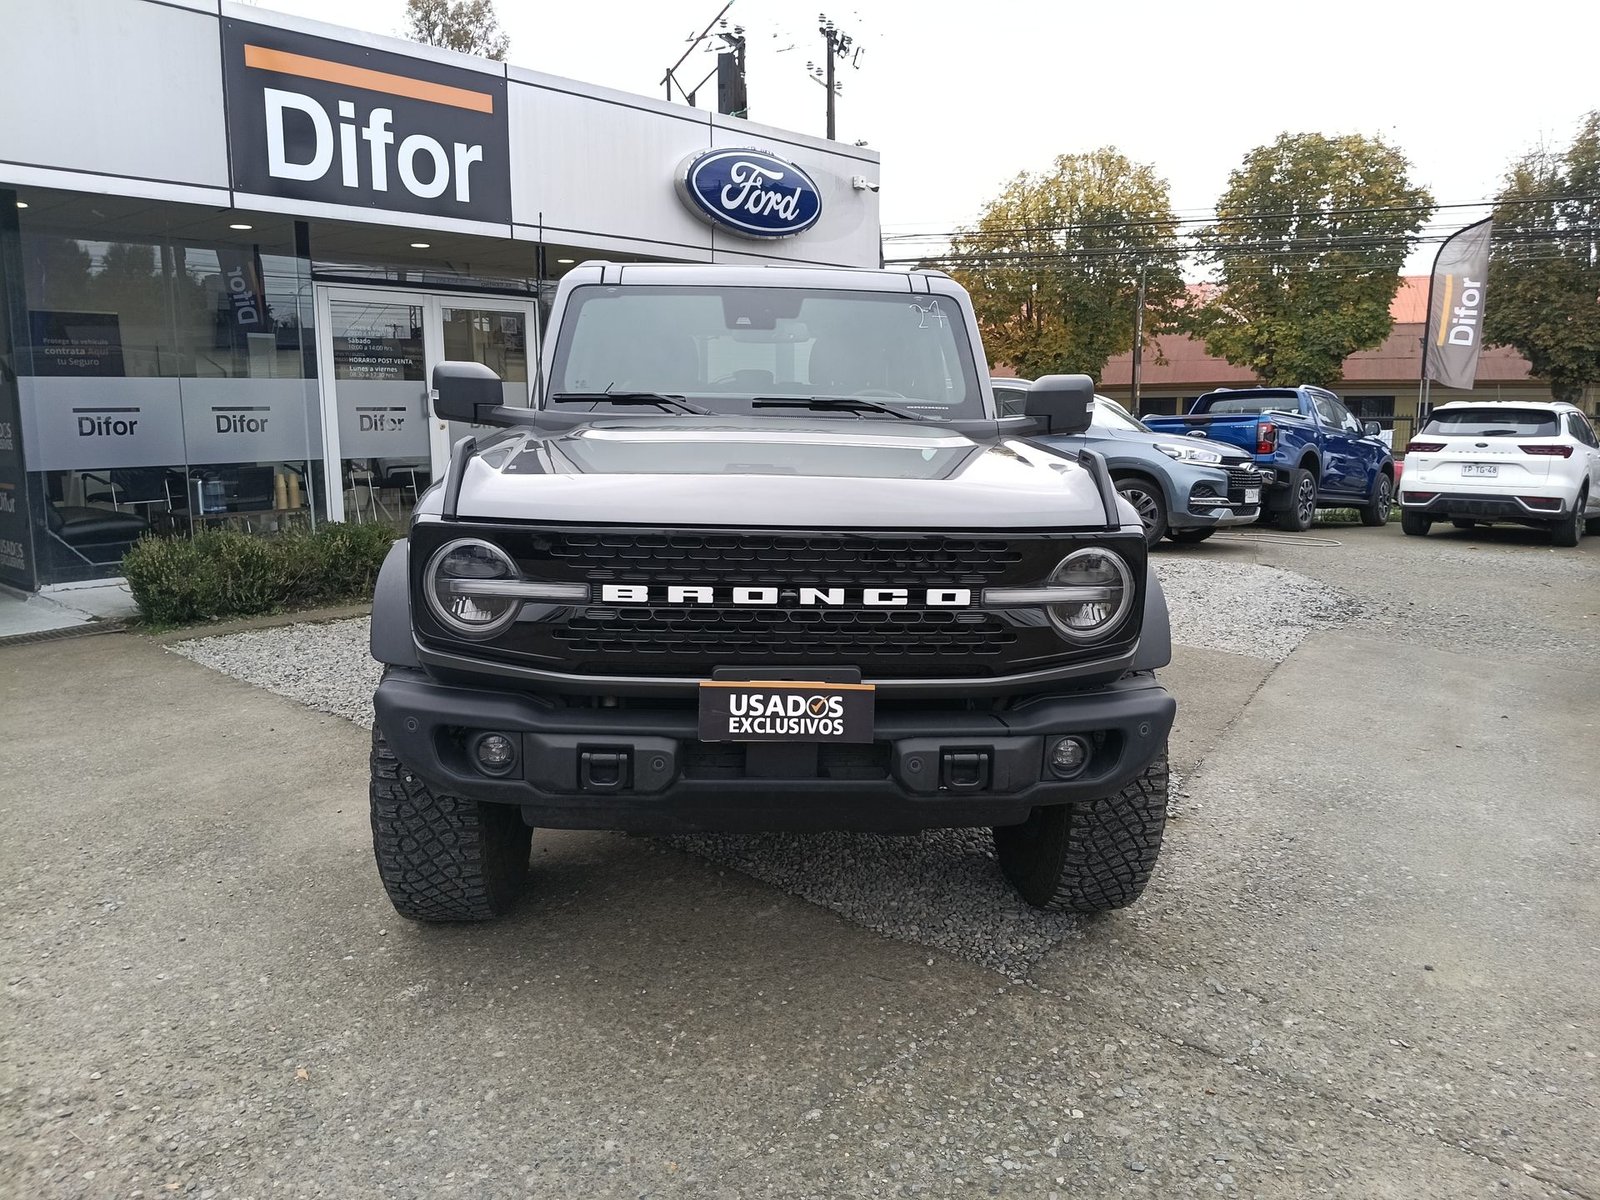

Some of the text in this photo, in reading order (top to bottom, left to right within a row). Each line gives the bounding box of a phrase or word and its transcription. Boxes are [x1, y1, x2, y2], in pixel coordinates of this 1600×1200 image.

[264, 88, 483, 203] Difor
[721, 162, 802, 220] Ford
[1448, 277, 1481, 346] Difor
[69, 358, 99, 367] Seguro
[78, 416, 138, 437] Difor
[215, 414, 268, 434] Difor
[359, 414, 405, 432] Difor
[602, 584, 971, 605] BRONCO
[729, 694, 844, 718] USADOS
[728, 717, 844, 735] EXCLUSIVOS
